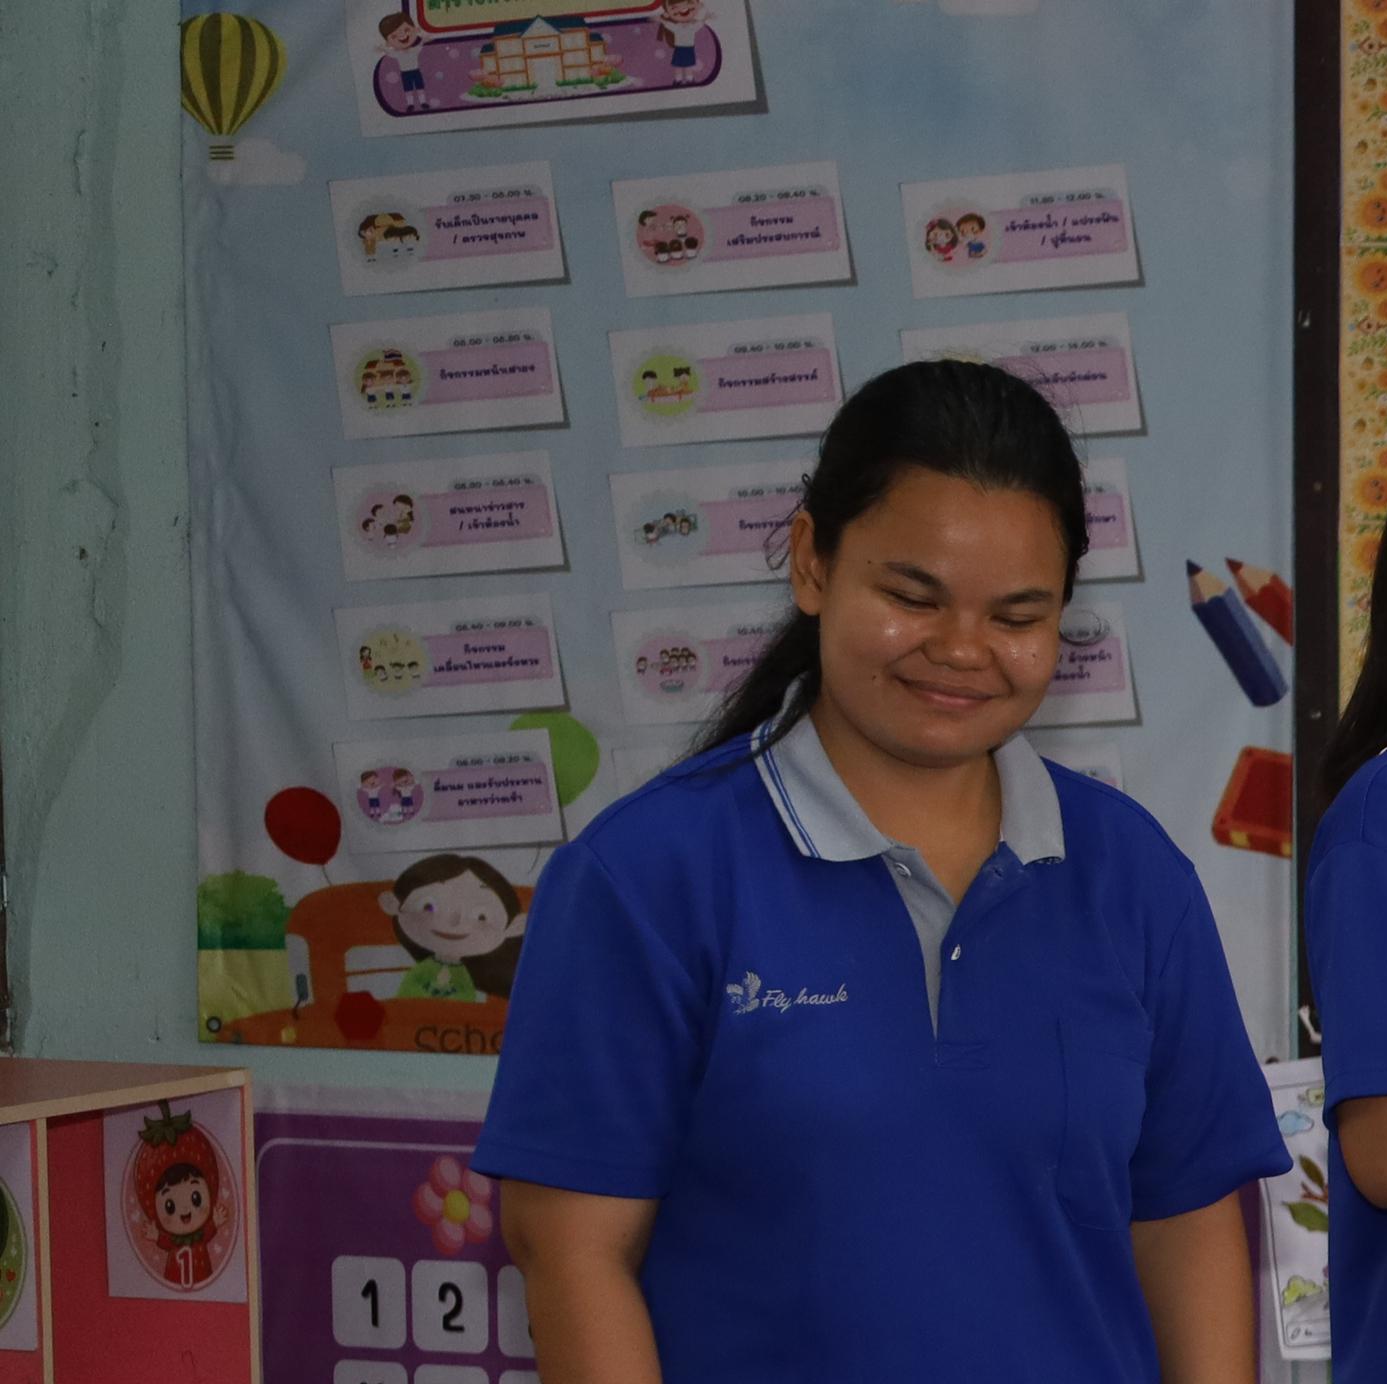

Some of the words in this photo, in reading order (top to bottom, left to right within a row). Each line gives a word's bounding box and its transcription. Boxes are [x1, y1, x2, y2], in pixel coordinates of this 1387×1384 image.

[761, 989, 793, 1013] Fly
[791, 983, 849, 1006] hawk
[176, 1246, 194, 1289] 1
[361, 1278, 380, 1328] 1
[437, 1281, 465, 1333] 2
